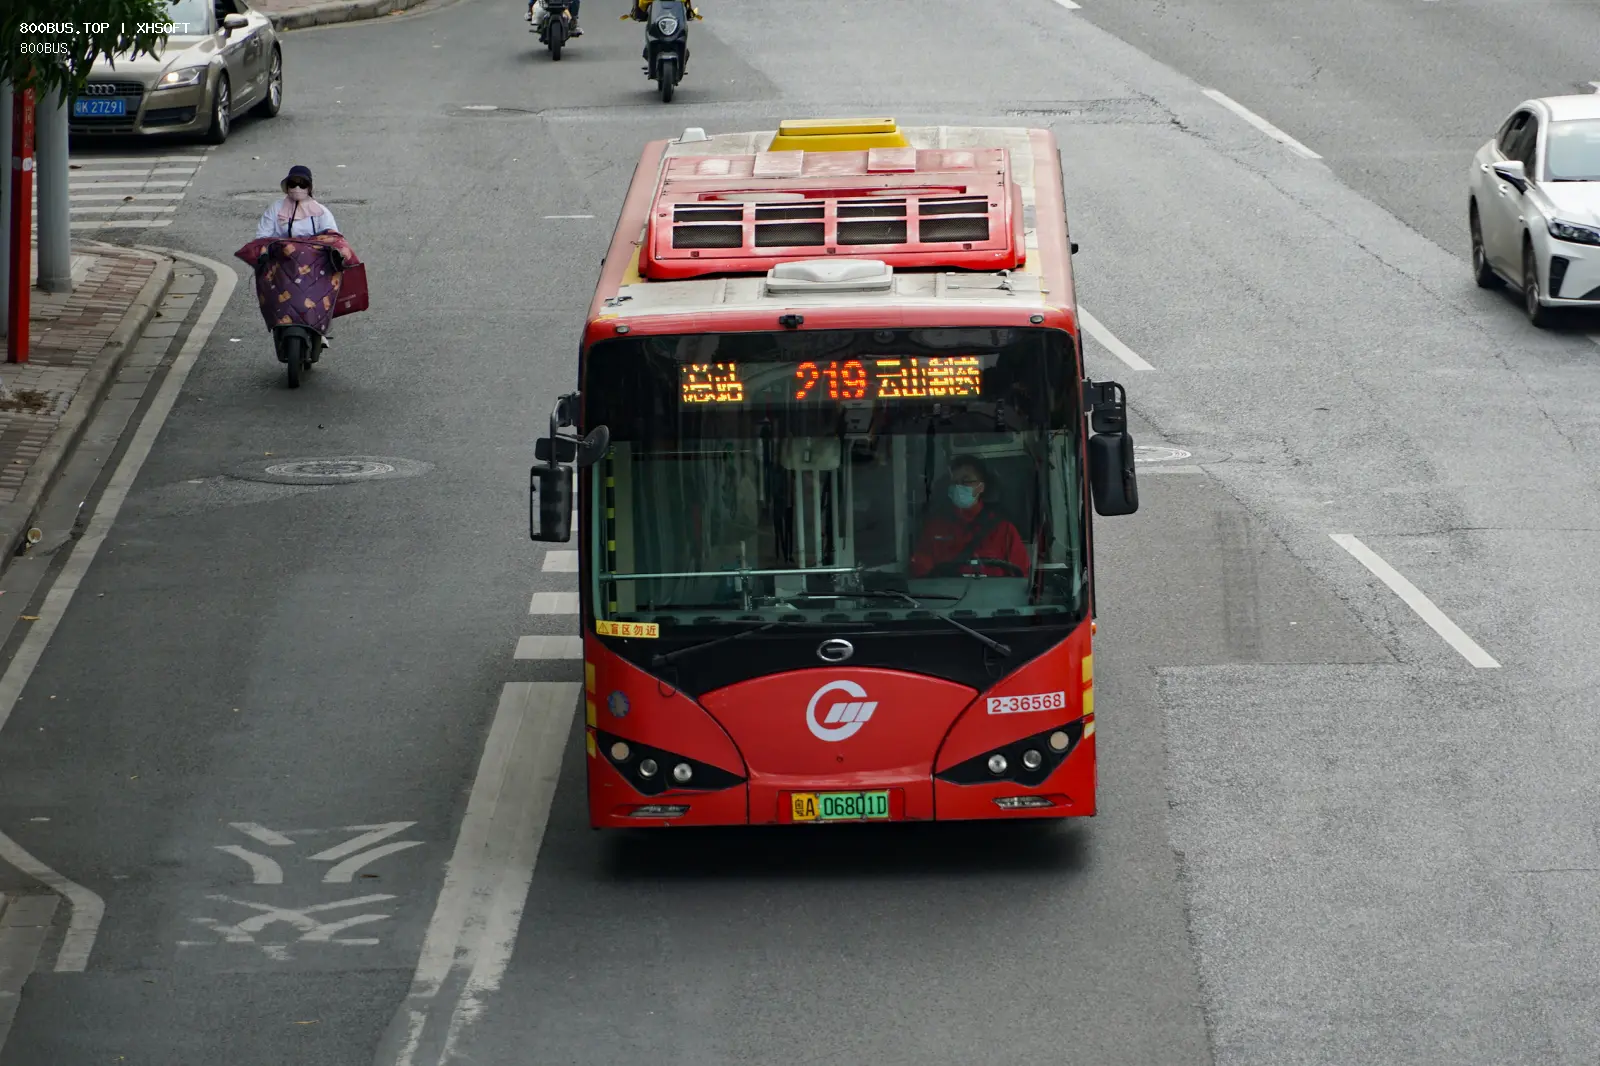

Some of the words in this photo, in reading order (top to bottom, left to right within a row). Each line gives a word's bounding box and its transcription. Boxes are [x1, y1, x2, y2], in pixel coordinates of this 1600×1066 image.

[610, 623, 657, 637] 盲区勿近
[991, 693, 1062, 713] 2-36568
[823, 795, 887, 816] 06801D
